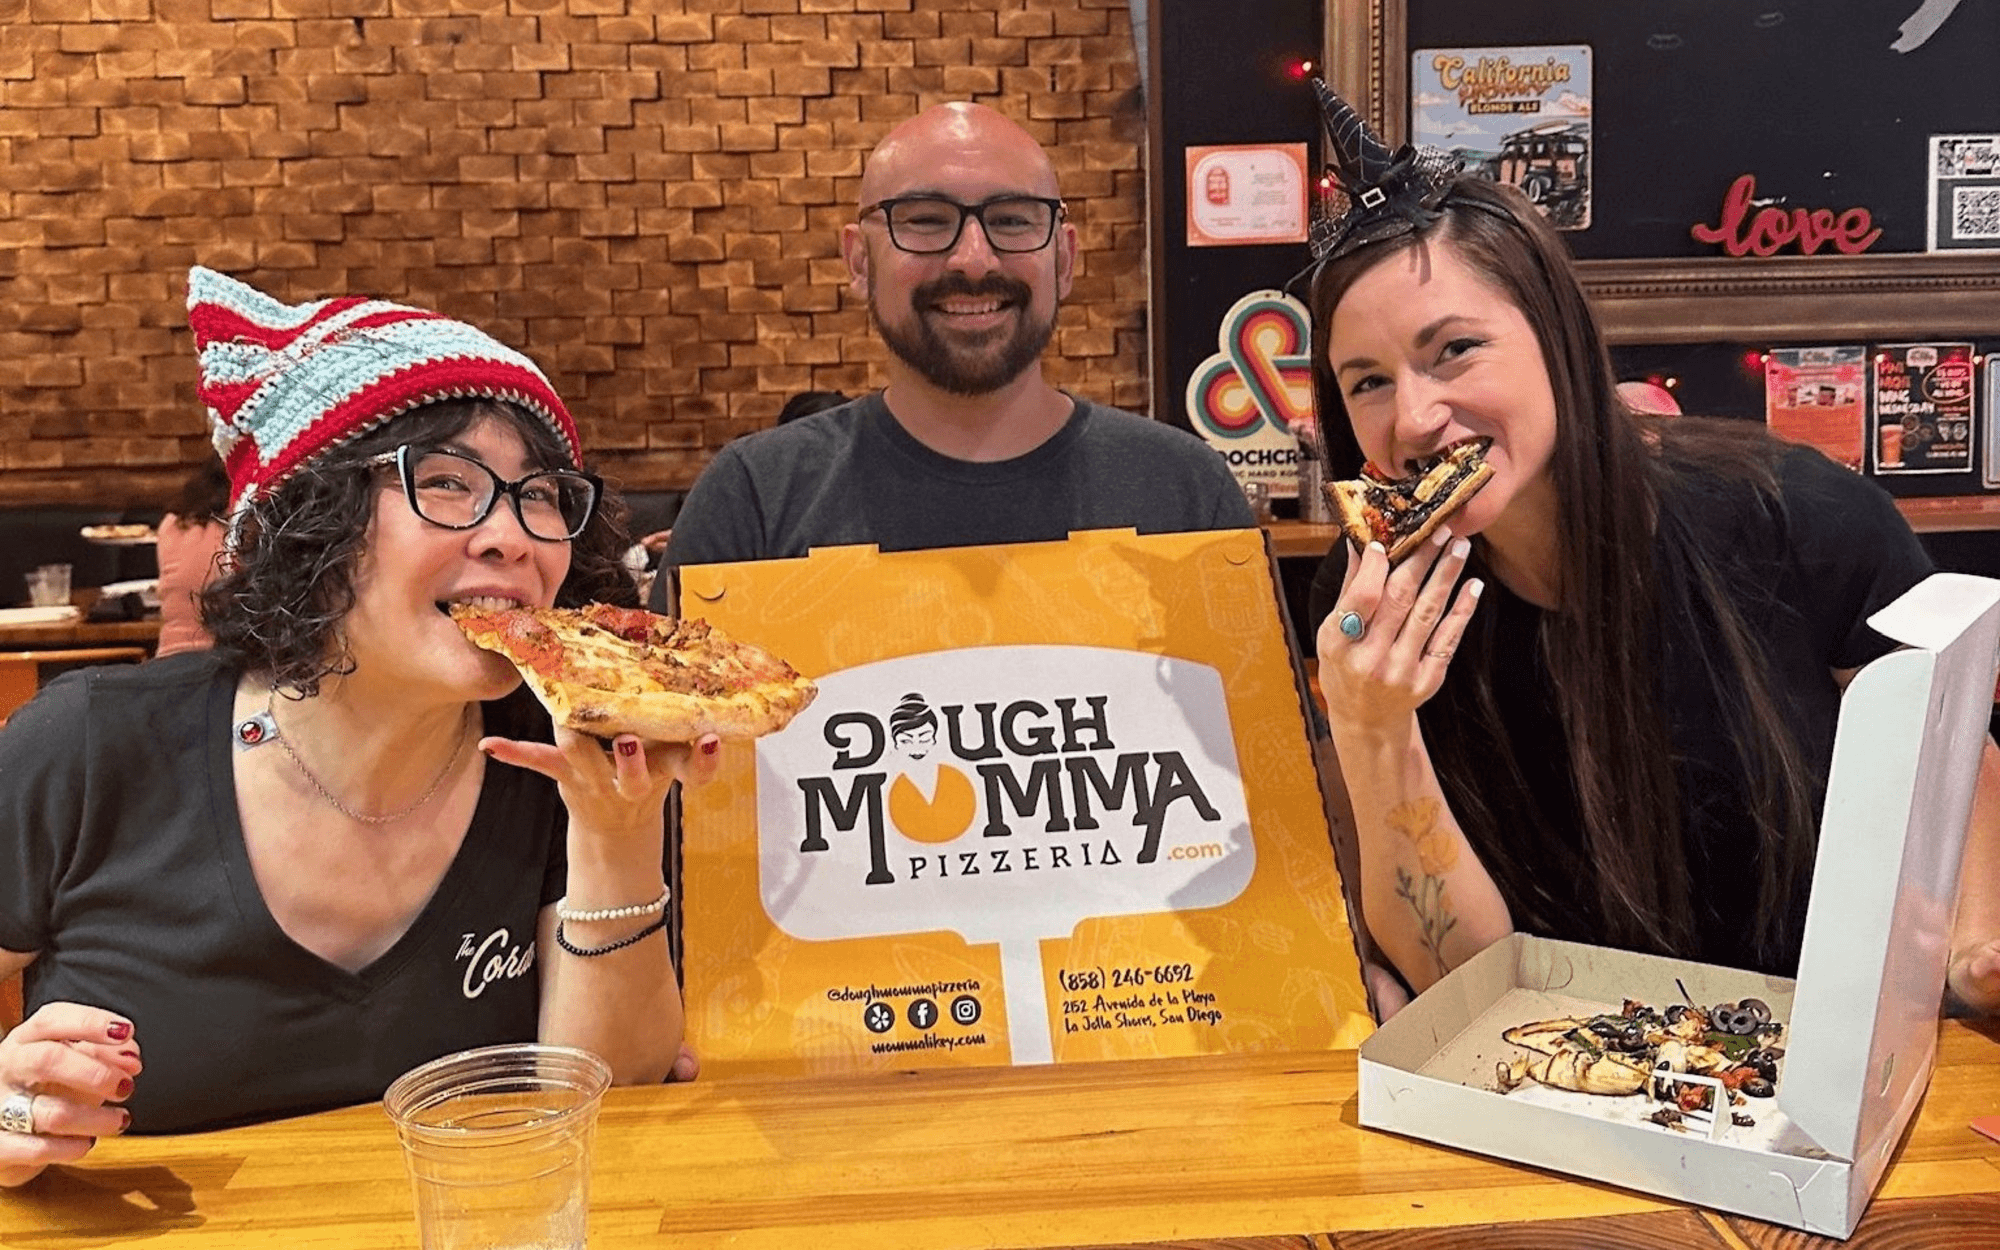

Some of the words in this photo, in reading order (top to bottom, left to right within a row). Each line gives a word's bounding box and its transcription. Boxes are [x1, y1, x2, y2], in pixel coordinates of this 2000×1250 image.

[1432, 55, 1570, 90] California
[1518, 102, 1539, 112] ALE
[1691, 174, 1883, 256] love
[797, 751, 1221, 885] MOMMA
[909, 840, 1122, 880] PIZZERIA
[1167, 841, 1223, 861] .com
[455, 933, 475, 960] The
[1059, 966, 1106, 992] (858)
[1112, 963, 1194, 988] 246-6692
[827, 979, 980, 1006] @doughmommapizzeria
[1063, 1000, 1088, 1014] 2152
[1092, 994, 1145, 1012] Avenida
[1149, 992, 1163, 1006] de
[1166, 991, 1179, 1005] la
[1182, 989, 1216, 1007] Playa
[1065, 1017, 1079, 1034] La
[1083, 1014, 1112, 1031] Jolla
[1159, 1008, 1185, 1025] San
[1187, 1006, 1223, 1026] Diego
[872, 1033, 986, 1053] mommalikey.com
